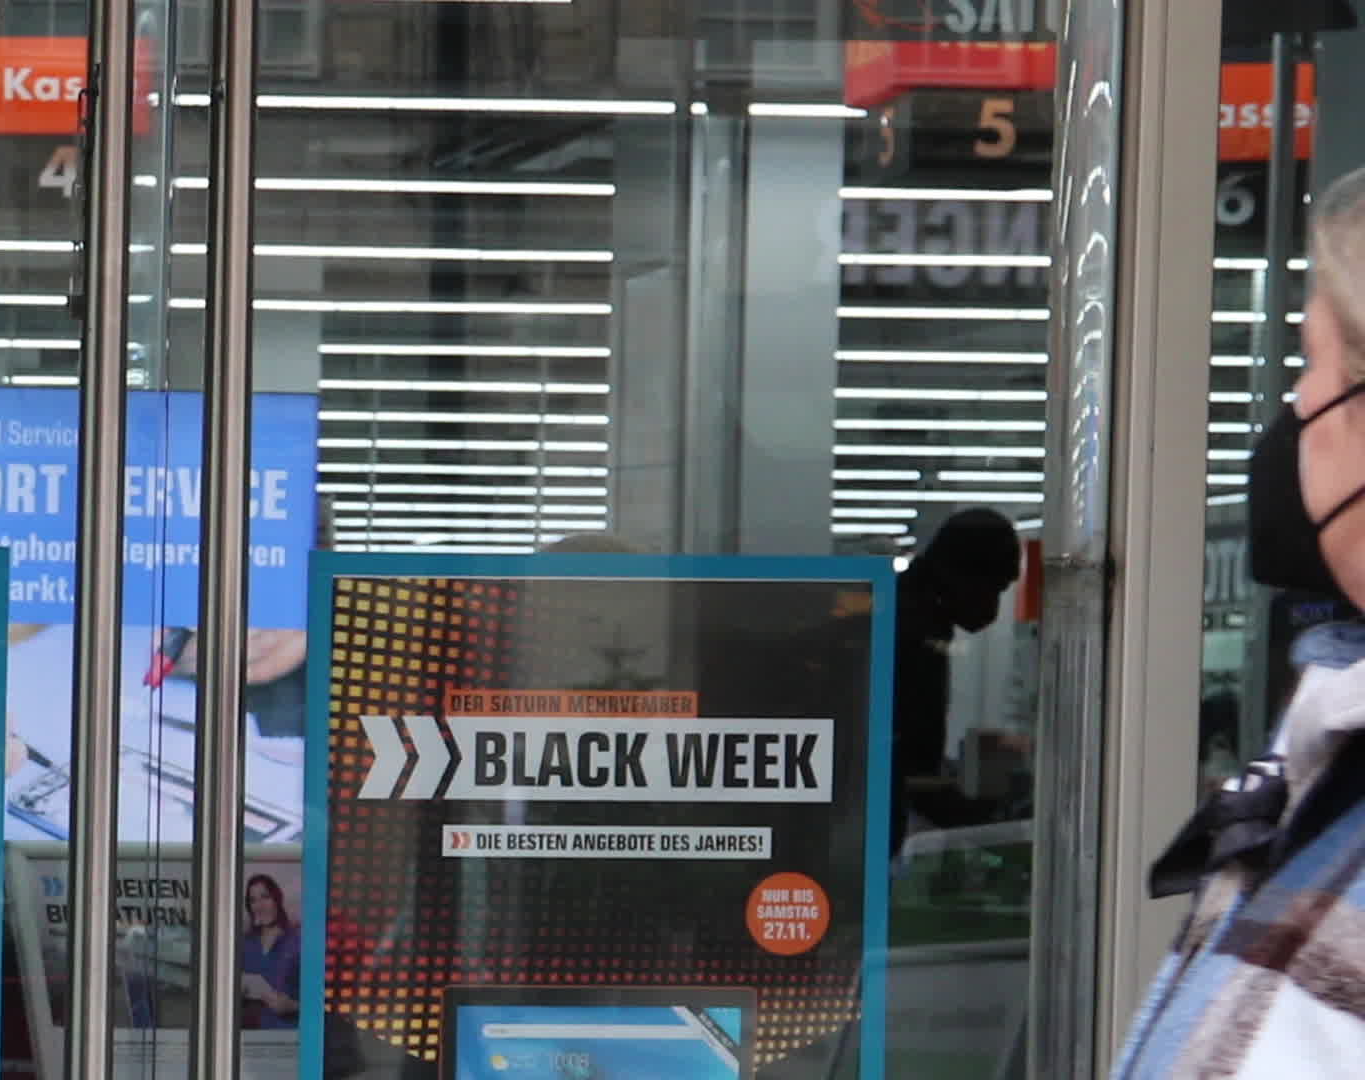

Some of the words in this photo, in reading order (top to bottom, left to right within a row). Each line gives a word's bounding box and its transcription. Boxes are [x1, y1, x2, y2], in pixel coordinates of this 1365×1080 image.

[3, 67, 83, 101] Kas
[1220, 103, 1312, 128] asse
[974, 99, 1017, 157] 5
[39, 146, 78, 197] 4
[1216, 172, 1255, 226] 6
[9, 573, 76, 603] arkt.
[451, 694, 484, 712] DER
[491, 695, 561, 713] SATURN
[568, 695, 692, 714] MEHRVEMBER
[474, 731, 648, 788] BLACK
[666, 732, 818, 789] WEEK
[476, 832, 503, 850] DIE
[507, 833, 567, 851] BESTEN
[572, 834, 656, 852] ANGEBOTE
[660, 835, 690, 852] DES
[695, 835, 764, 853] JAHRES!
[116, 879, 190, 899] EITEN
[761, 889, 789, 903] NUR
[792, 889, 814, 903] BIS
[116, 905, 190, 928] TURN
[756, 903, 818, 920] SAMSTAG
[763, 921, 810, 940] 27.11.
